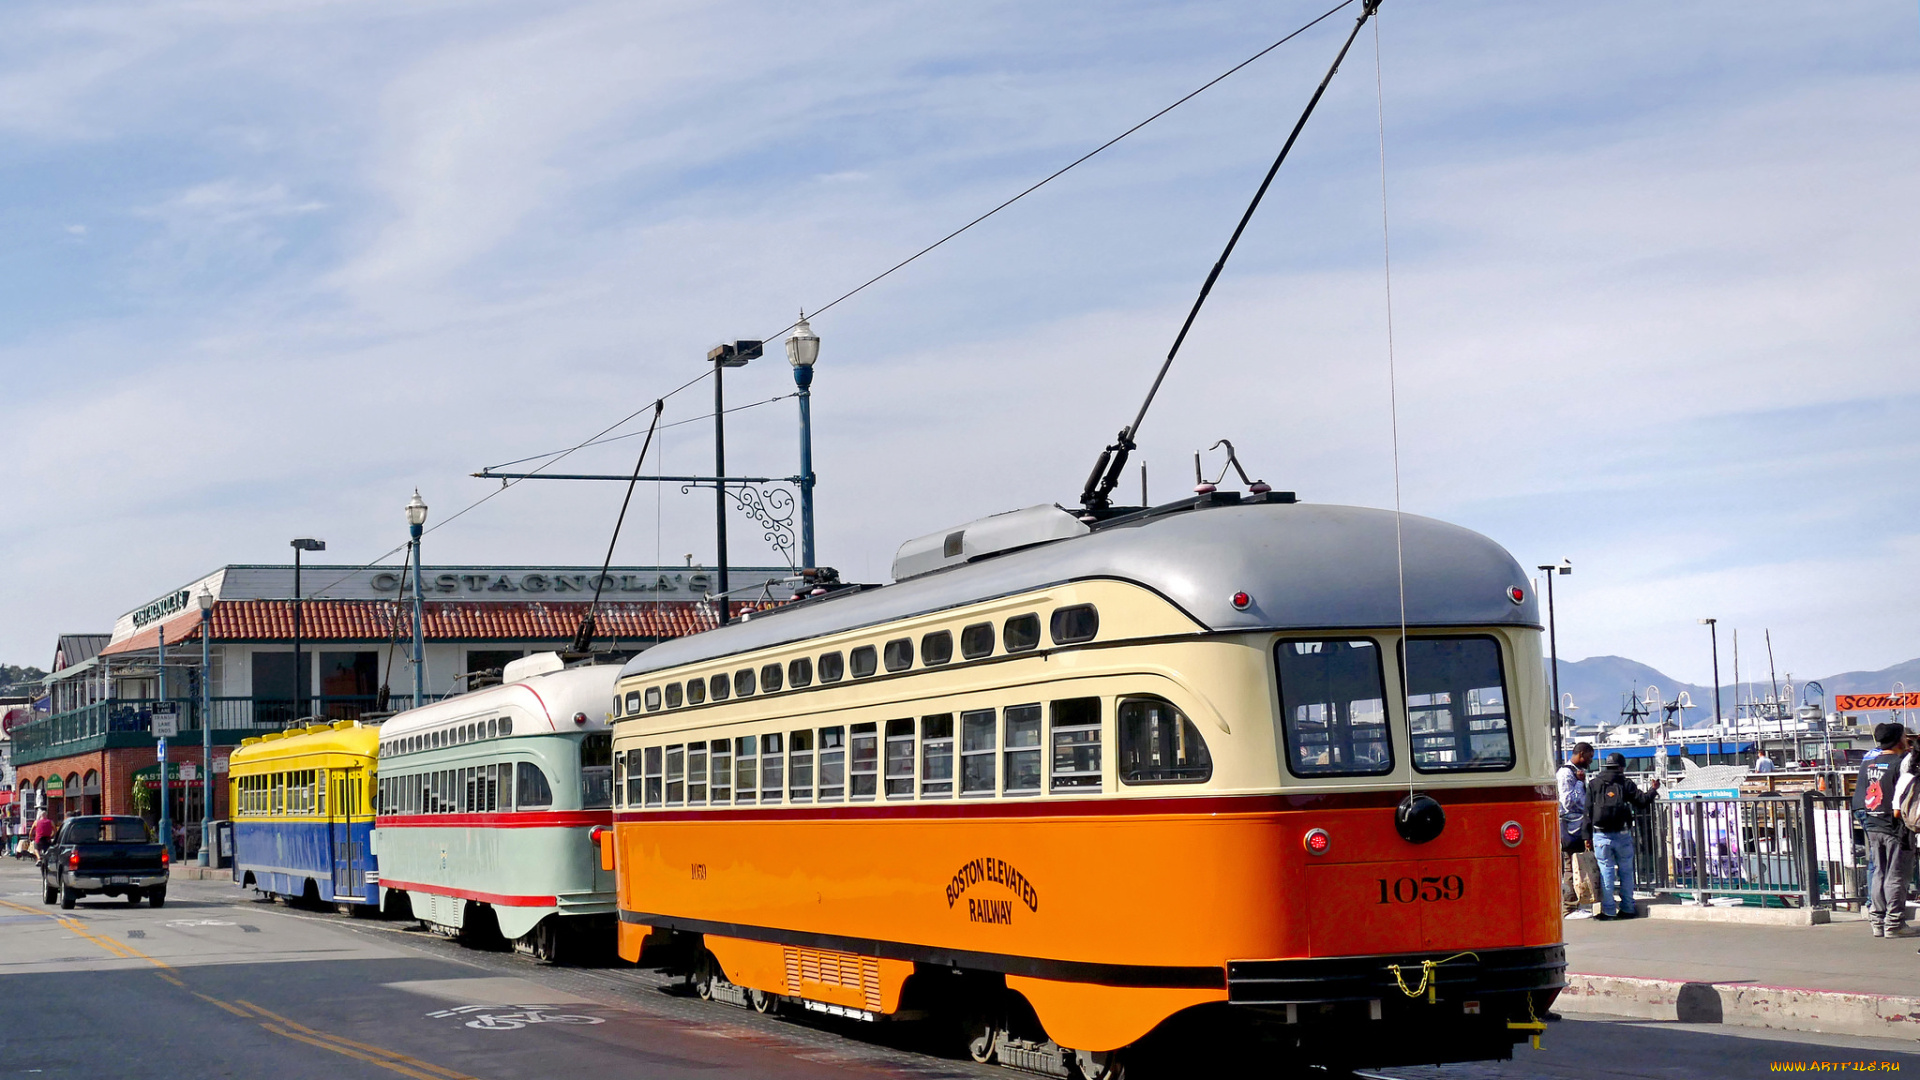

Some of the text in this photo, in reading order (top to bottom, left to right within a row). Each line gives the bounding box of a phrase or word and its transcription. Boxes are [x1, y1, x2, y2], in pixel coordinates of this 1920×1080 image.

[946, 857, 1038, 913] BOSTON ELEVATED
[1376, 874, 1464, 904] 1059
[968, 898, 1012, 925] RAILWAY
